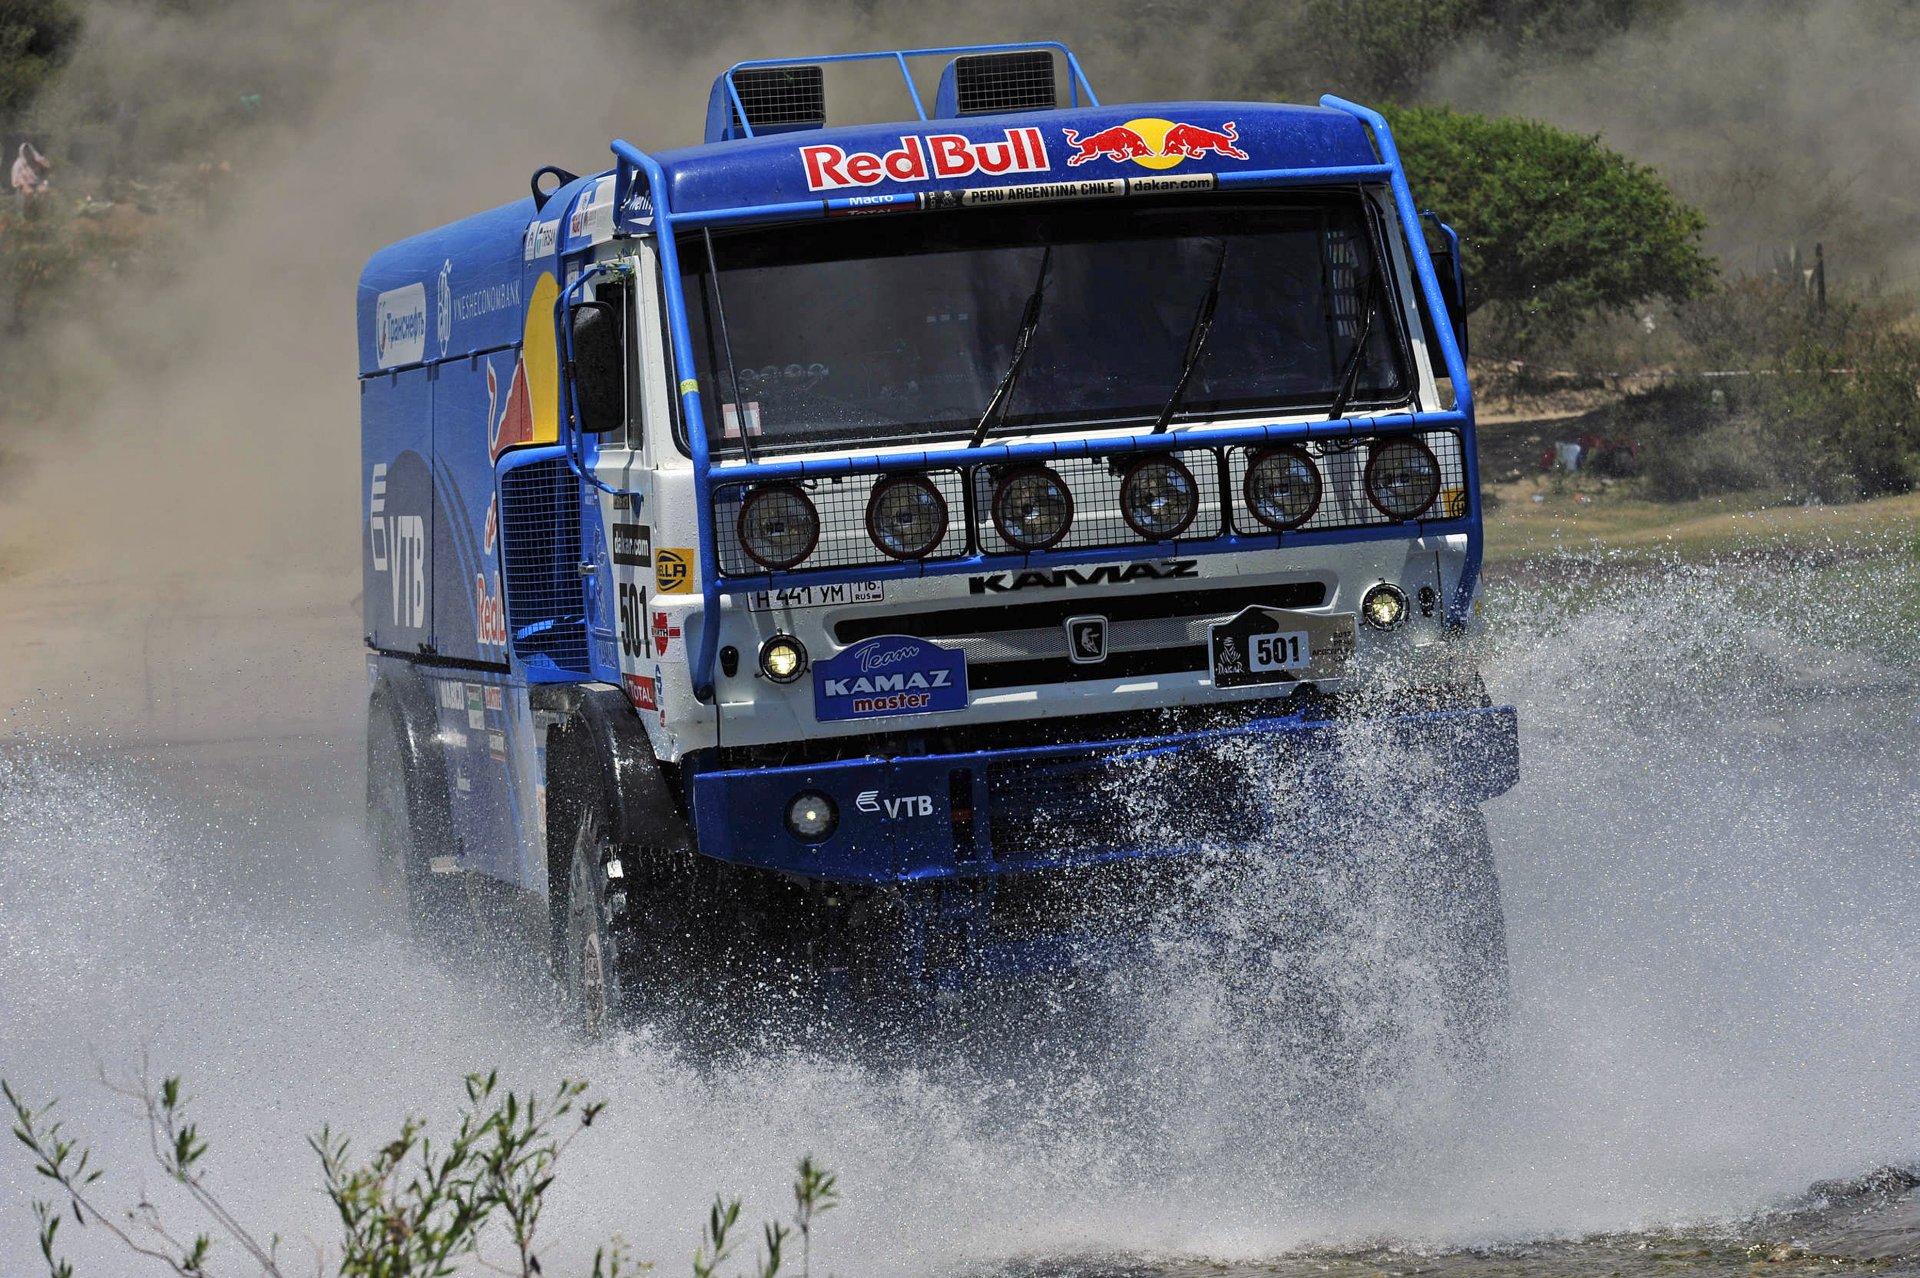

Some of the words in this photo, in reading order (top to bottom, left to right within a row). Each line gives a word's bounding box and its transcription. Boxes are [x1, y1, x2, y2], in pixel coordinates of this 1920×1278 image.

[800, 136, 930, 191] Red
[927, 126, 1051, 179] Bull
[971, 190, 1004, 203] PERU
[1007, 184, 1077, 200] ARGENTINA
[1081, 181, 1115, 195] CHILE
[1133, 178, 1211, 191] dakar.com
[849, 194, 894, 206] Macro
[453, 280, 521, 321] VNESHECONOMBANK
[390, 515, 425, 628] VTB
[968, 560, 1199, 594] KAMAZ
[619, 583, 651, 658] 501
[855, 642, 919, 672] Team
[1257, 637, 1300, 665] 501
[1217, 662, 1244, 675] DAKAR
[824, 670, 951, 697] KAMAZ
[853, 693, 930, 713] master
[884, 796, 934, 819] VTB
